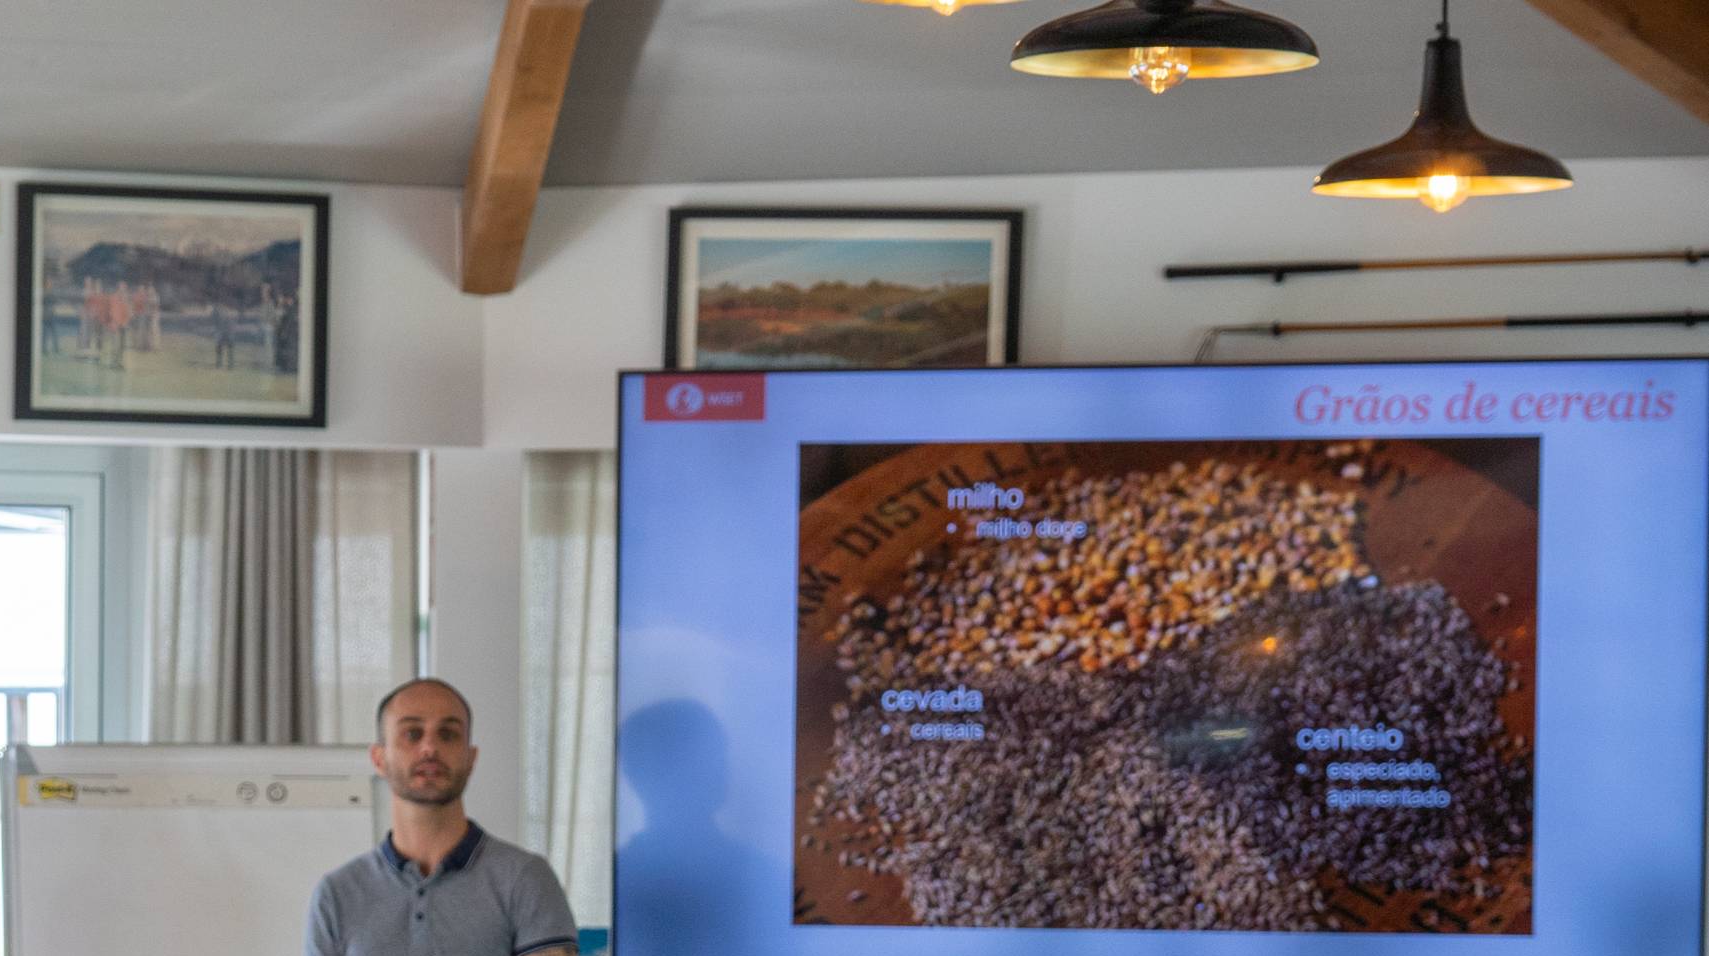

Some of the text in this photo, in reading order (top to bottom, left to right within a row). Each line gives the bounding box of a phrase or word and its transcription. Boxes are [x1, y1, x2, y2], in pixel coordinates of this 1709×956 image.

[1293, 379, 1679, 426] Grãos de cereais
[946, 482, 1025, 511] milho
[975, 518, 1033, 540] milho
[880, 684, 984, 712] cevada
[909, 720, 986, 741] cereais
[1295, 722, 1405, 751] centeio
[1326, 786, 1452, 811] apimentado
